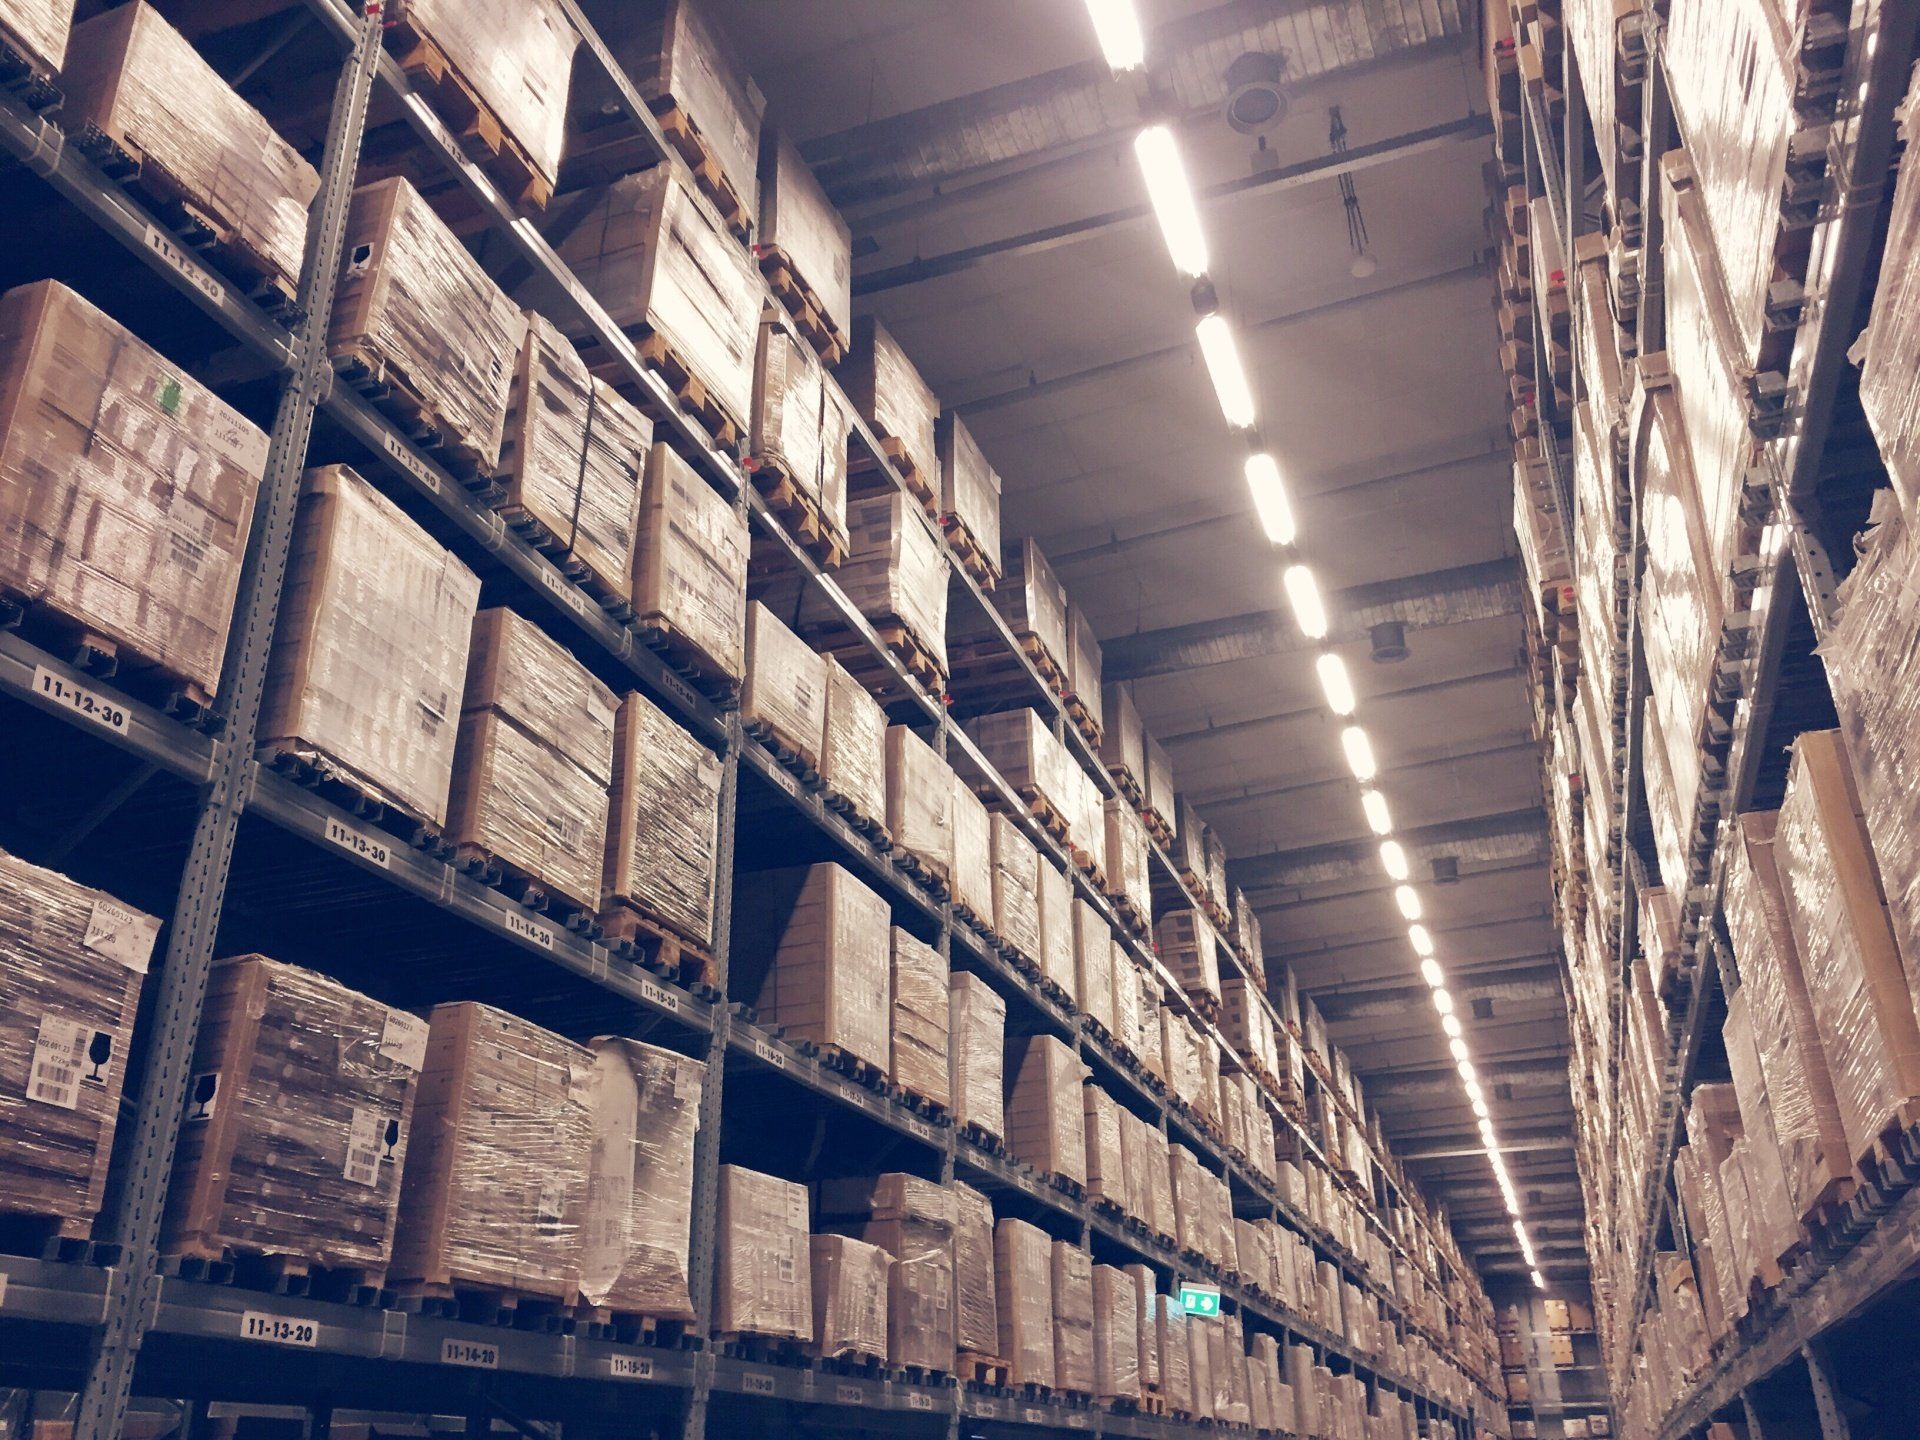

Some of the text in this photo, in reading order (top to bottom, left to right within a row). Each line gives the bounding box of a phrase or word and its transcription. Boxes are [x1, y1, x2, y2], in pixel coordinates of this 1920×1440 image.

[153, 234, 219, 298] 11-12-40
[390, 439, 437, 488] 11-13-40
[43, 674, 124, 728] 11-12-30
[331, 823, 387, 864] 11-13-30
[509, 915, 551, 947] 11-14-30
[644, 983, 677, 1009] 11-15-30
[248, 1317, 314, 1343] 11-13-20
[614, 1358, 652, 1376] 11-15-20
